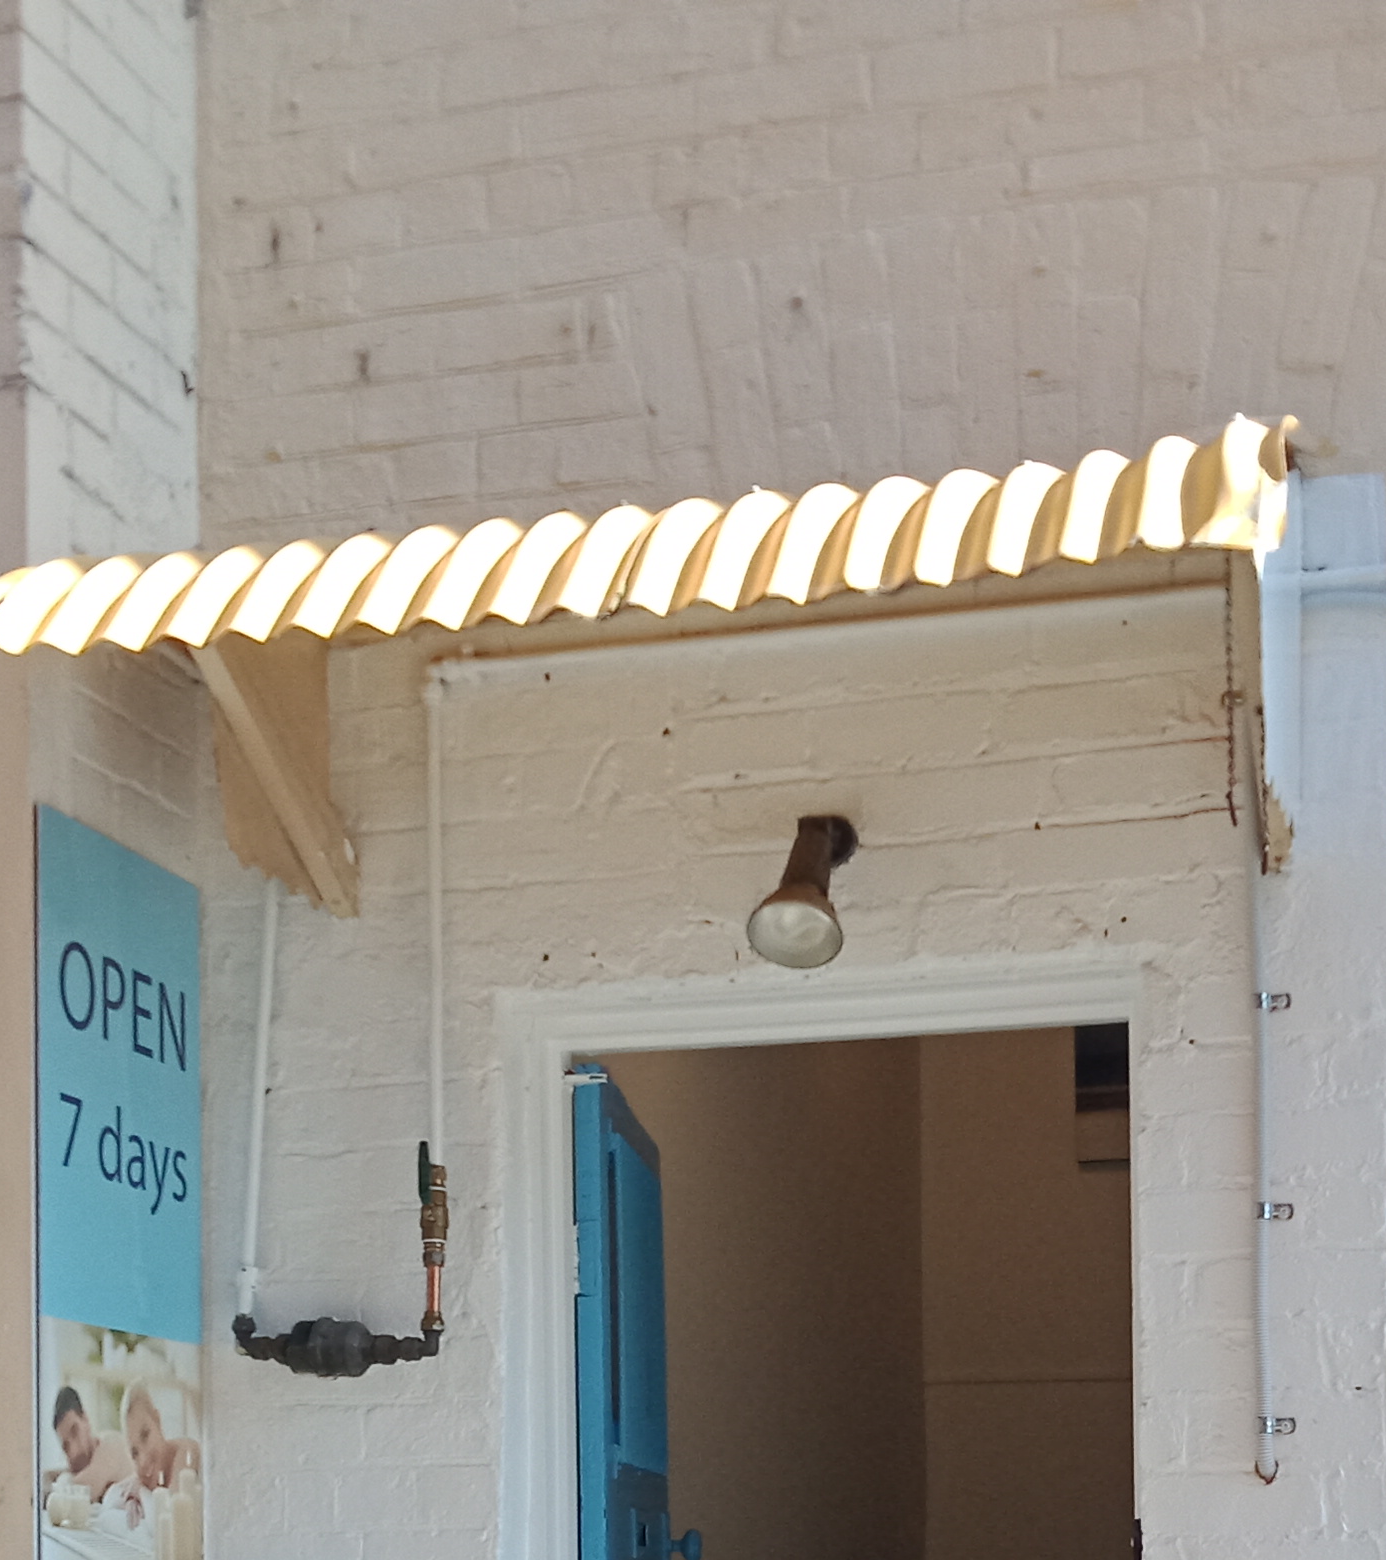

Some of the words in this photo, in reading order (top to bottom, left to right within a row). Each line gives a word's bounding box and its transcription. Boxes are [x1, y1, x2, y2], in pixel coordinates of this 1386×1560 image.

[59, 941, 187, 1072] OPEN
[59, 1092, 83, 1167] 7
[98, 1105, 188, 1216] days
